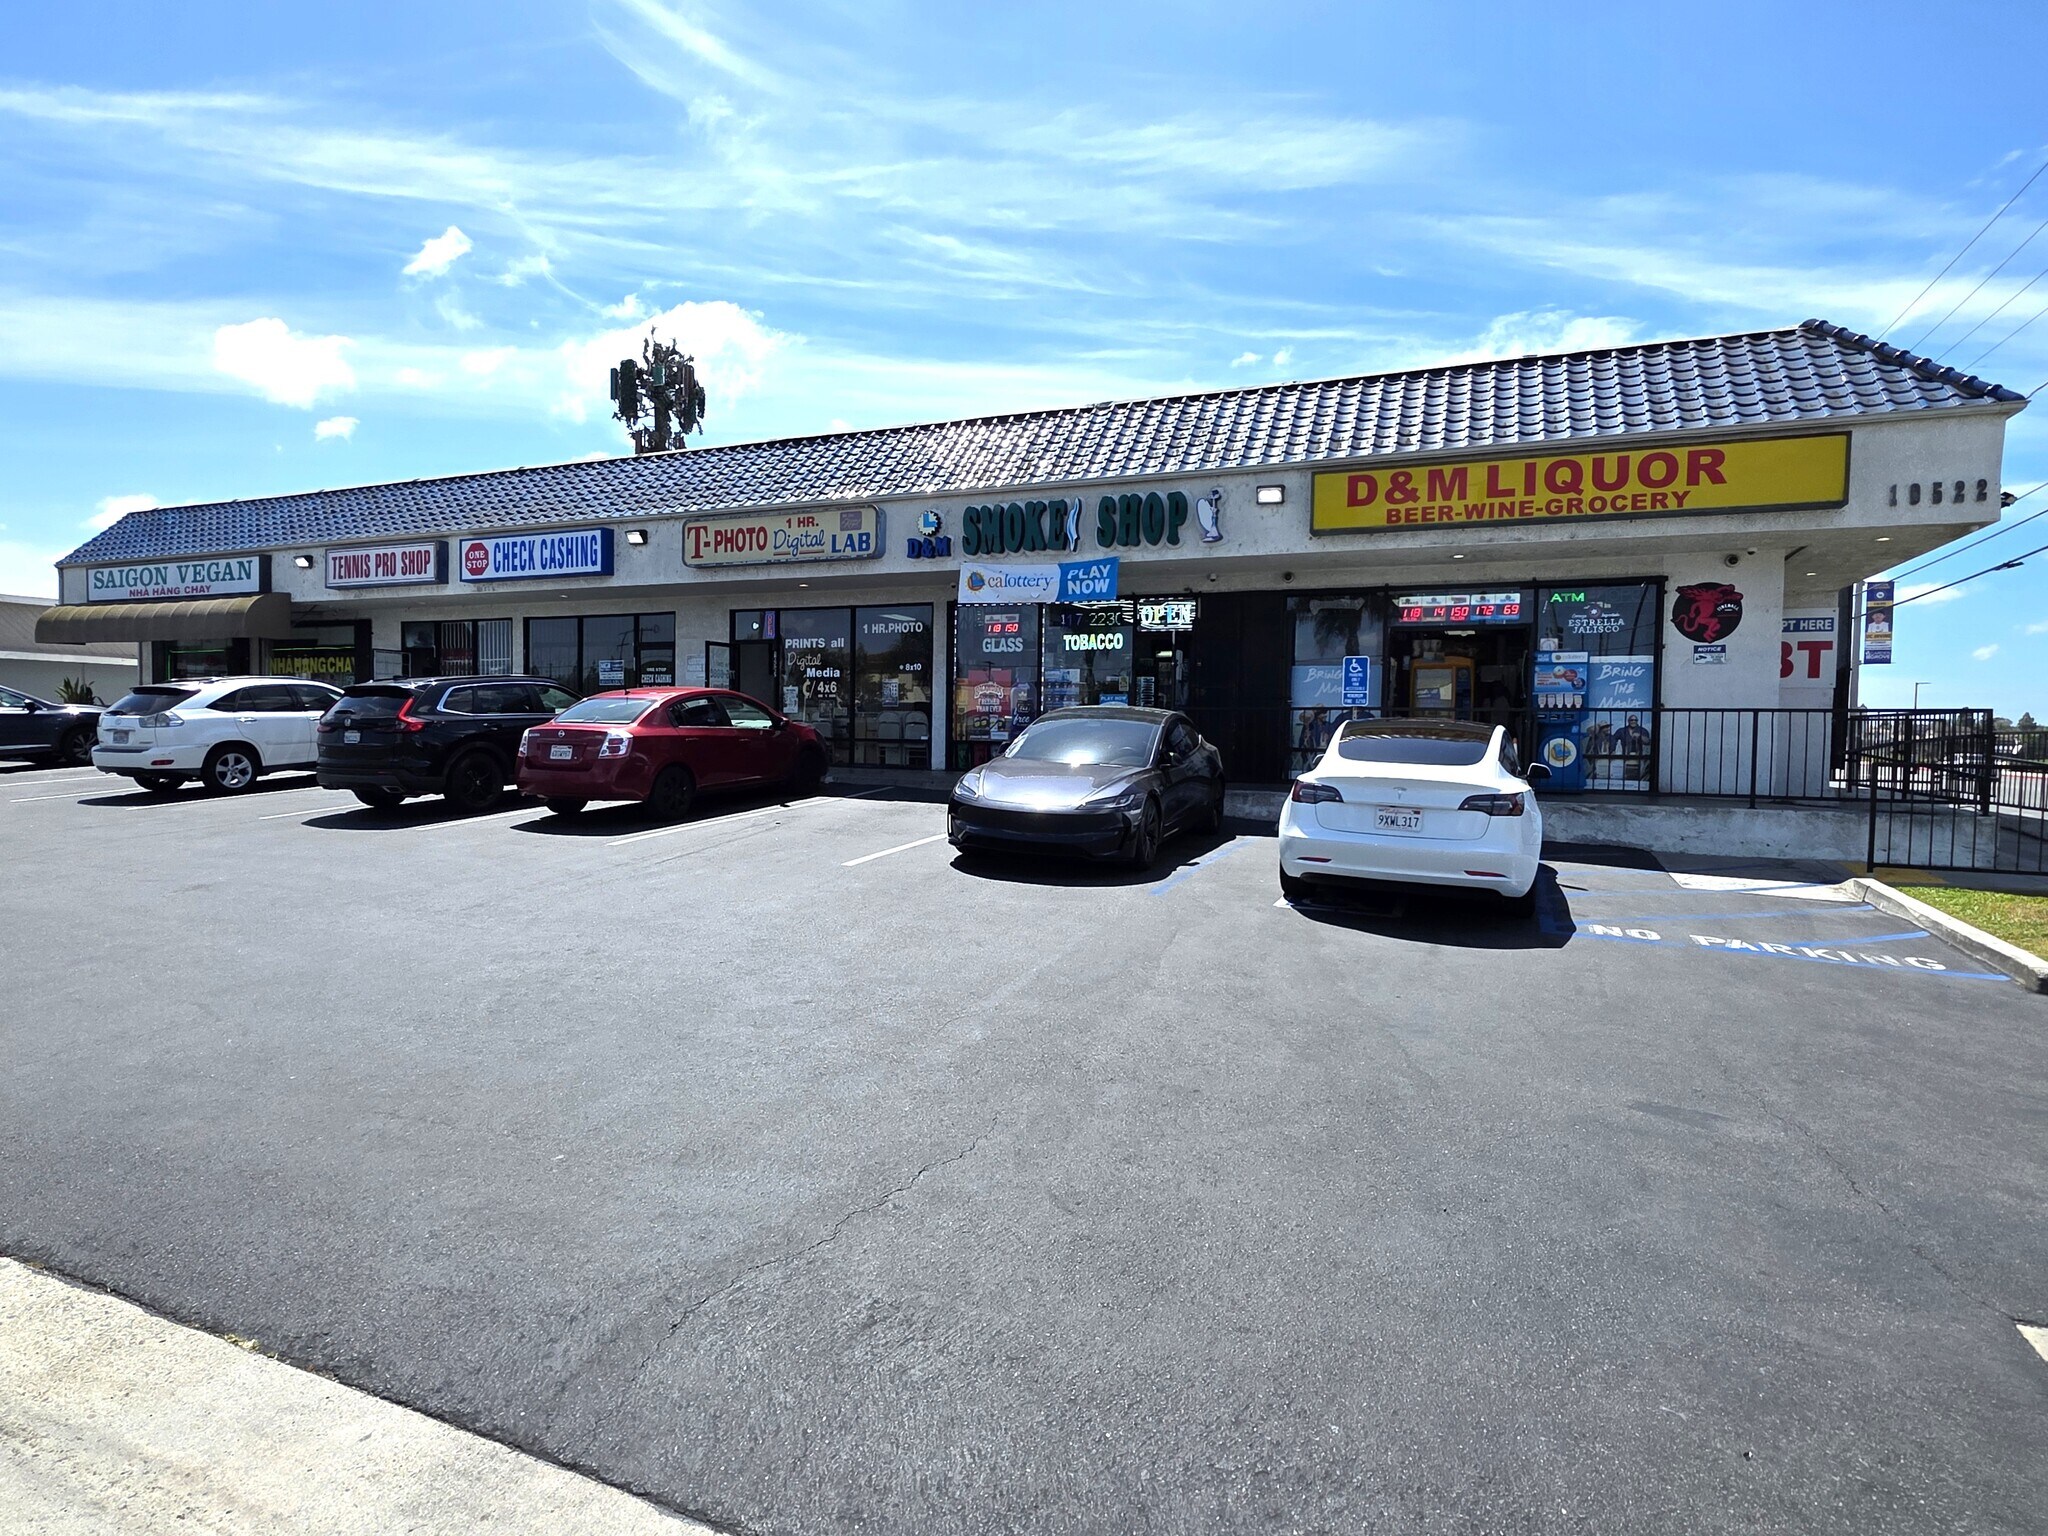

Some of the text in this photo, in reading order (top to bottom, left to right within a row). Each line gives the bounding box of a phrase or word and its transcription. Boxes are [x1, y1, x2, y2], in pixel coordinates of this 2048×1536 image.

[1346, 449, 1727, 507] D&M LIQUOR
[1889, 479, 1988, 506] 10522
[1386, 491, 1691, 524] BEER-WINE-GROCERY
[786, 517, 819, 529] 1 HR.
[962, 491, 1188, 556] SMOKE SHOP
[773, 529, 825, 557] Digital
[831, 532, 871, 553] LAB
[907, 536, 951, 559] D&M
[468, 550, 486, 559] ONE
[493, 534, 598, 573] CHECK CASHING
[331, 550, 430, 579] TENNIS PRO SHOP
[466, 560, 488, 569] STOP
[1067, 564, 1112, 579] PLAY
[93, 560, 253, 589] SAIGON VEGAN
[184, 585, 212, 594] CHAY
[1068, 578, 1110, 595] NOW
[1550, 592, 1585, 602] ATM
[1143, 604, 1193, 625] OPEN
[862, 624, 868, 633] 1
[1568, 619, 1625, 627] ESTRELLA
[1572, 625, 1620, 634] JALISCO
[1800, 619, 1832, 630] HERE
[785, 638, 845, 649] PRINTS all
[982, 638, 1024, 652] GLASS
[1063, 633, 1123, 651] TOBACCO
[787, 652, 822, 671] Digital
[806, 668, 840, 678] Media
[817, 681, 837, 693] 4x6
[1610, 680, 1635, 695] THE
[1378, 815, 1420, 828] 9XWL317
[1589, 924, 1947, 972] NO PARKING
